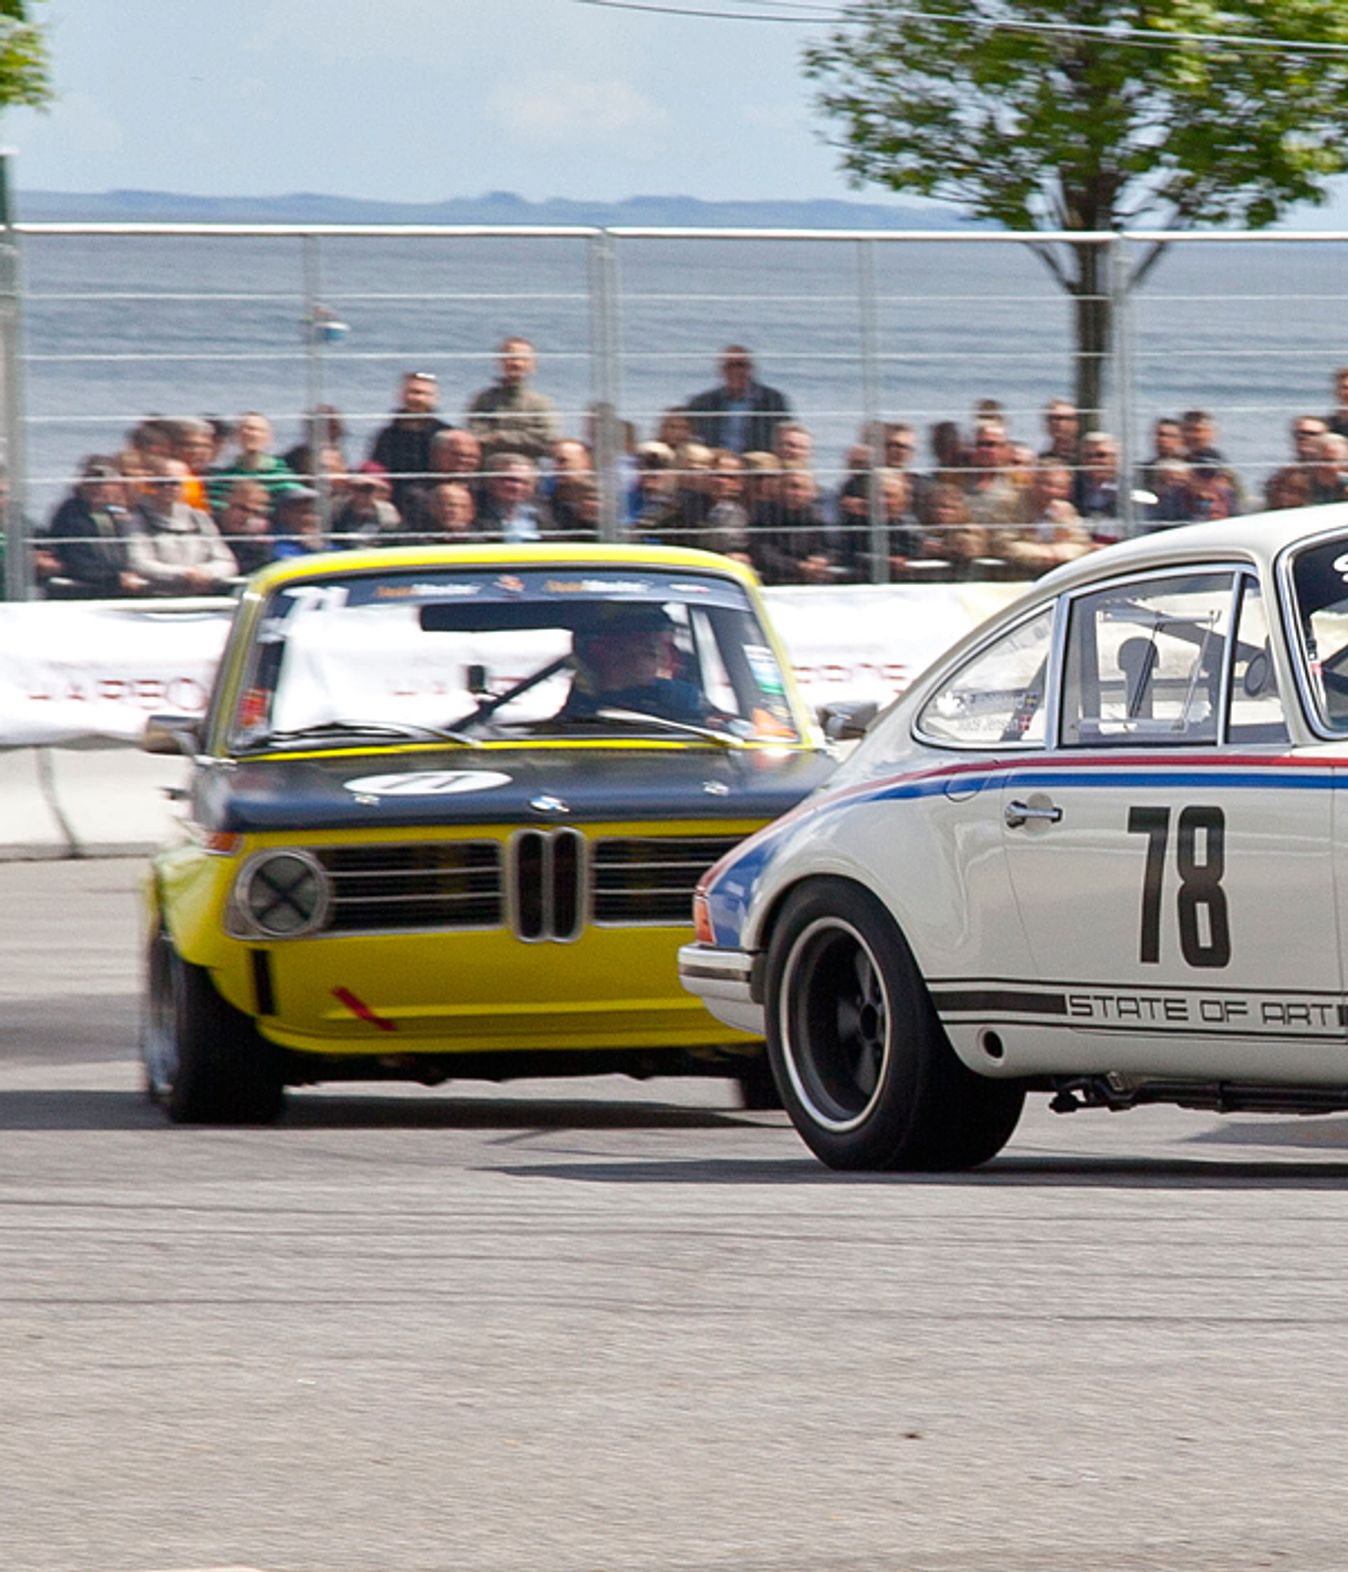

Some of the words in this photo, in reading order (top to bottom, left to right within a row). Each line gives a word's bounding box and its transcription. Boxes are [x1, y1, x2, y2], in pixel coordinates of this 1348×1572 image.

[1127, 806, 1231, 967] 78
[1068, 994, 1189, 1021] STATE
[1199, 999, 1248, 1023] OF
[1260, 1002, 1333, 1026] ART
